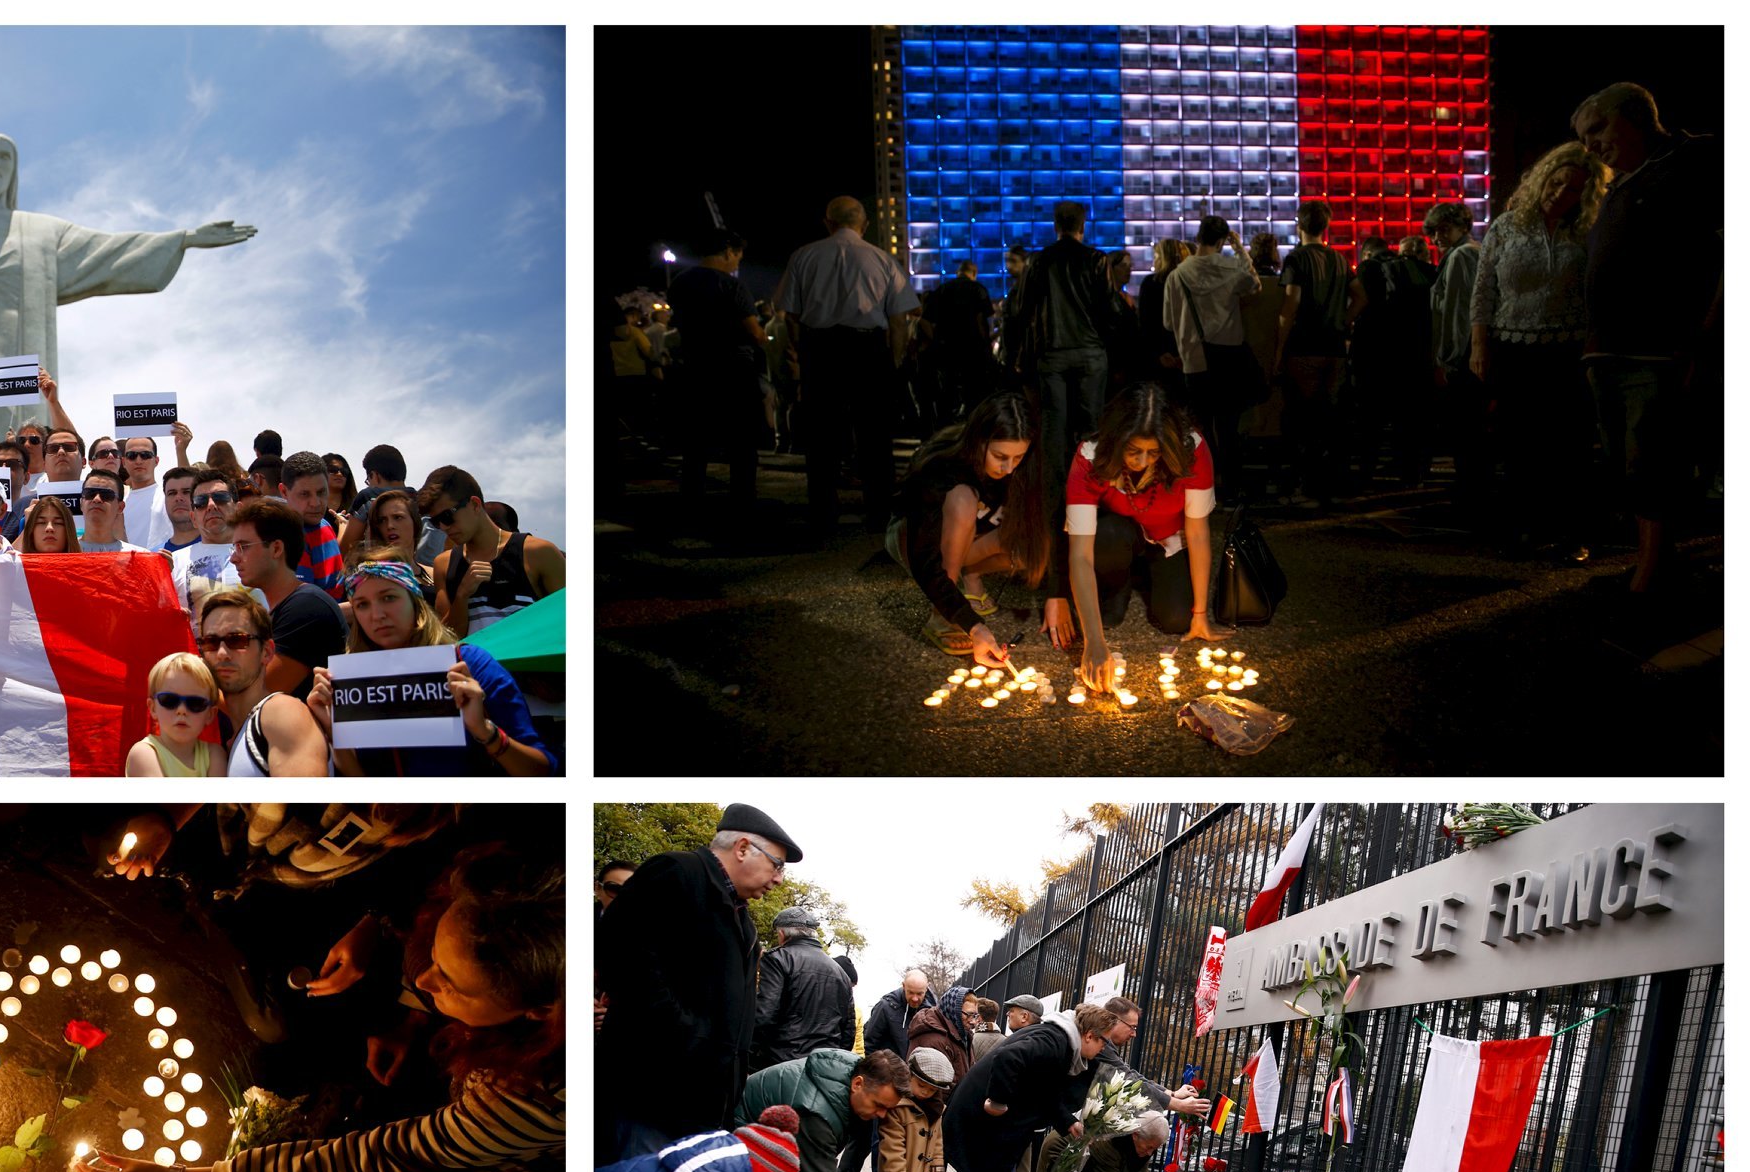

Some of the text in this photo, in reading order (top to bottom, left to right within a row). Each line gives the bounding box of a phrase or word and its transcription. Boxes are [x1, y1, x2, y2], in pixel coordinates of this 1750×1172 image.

[0, 381, 14, 390] EST
[15, 379, 37, 388] PARIS
[116, 408, 176, 419] RIO EST PARIS
[334, 682, 454, 706] RIO EST PARIS
[1411, 891, 1468, 962] DE
[1480, 822, 1688, 948] FRANCE
